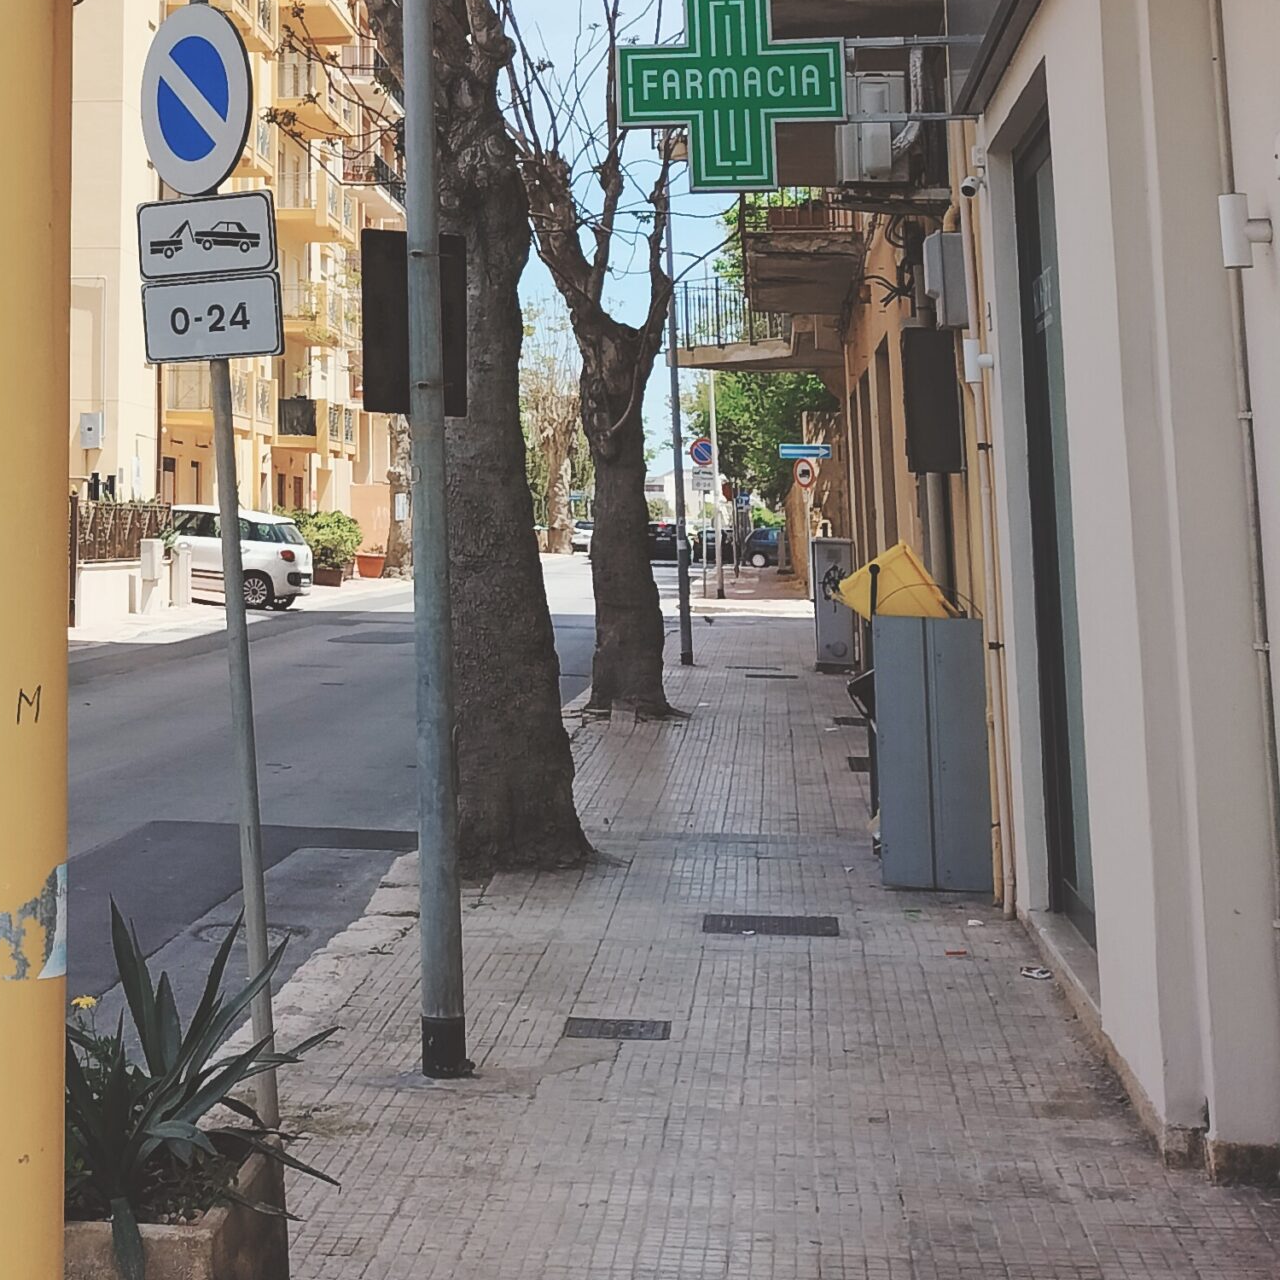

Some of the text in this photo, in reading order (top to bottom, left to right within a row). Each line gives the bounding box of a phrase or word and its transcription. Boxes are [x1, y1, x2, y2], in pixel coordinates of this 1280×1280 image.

[642, 64, 820, 101] FARMACIA
[170, 301, 251, 335] 0-24
[16, 684, 42, 725] M
